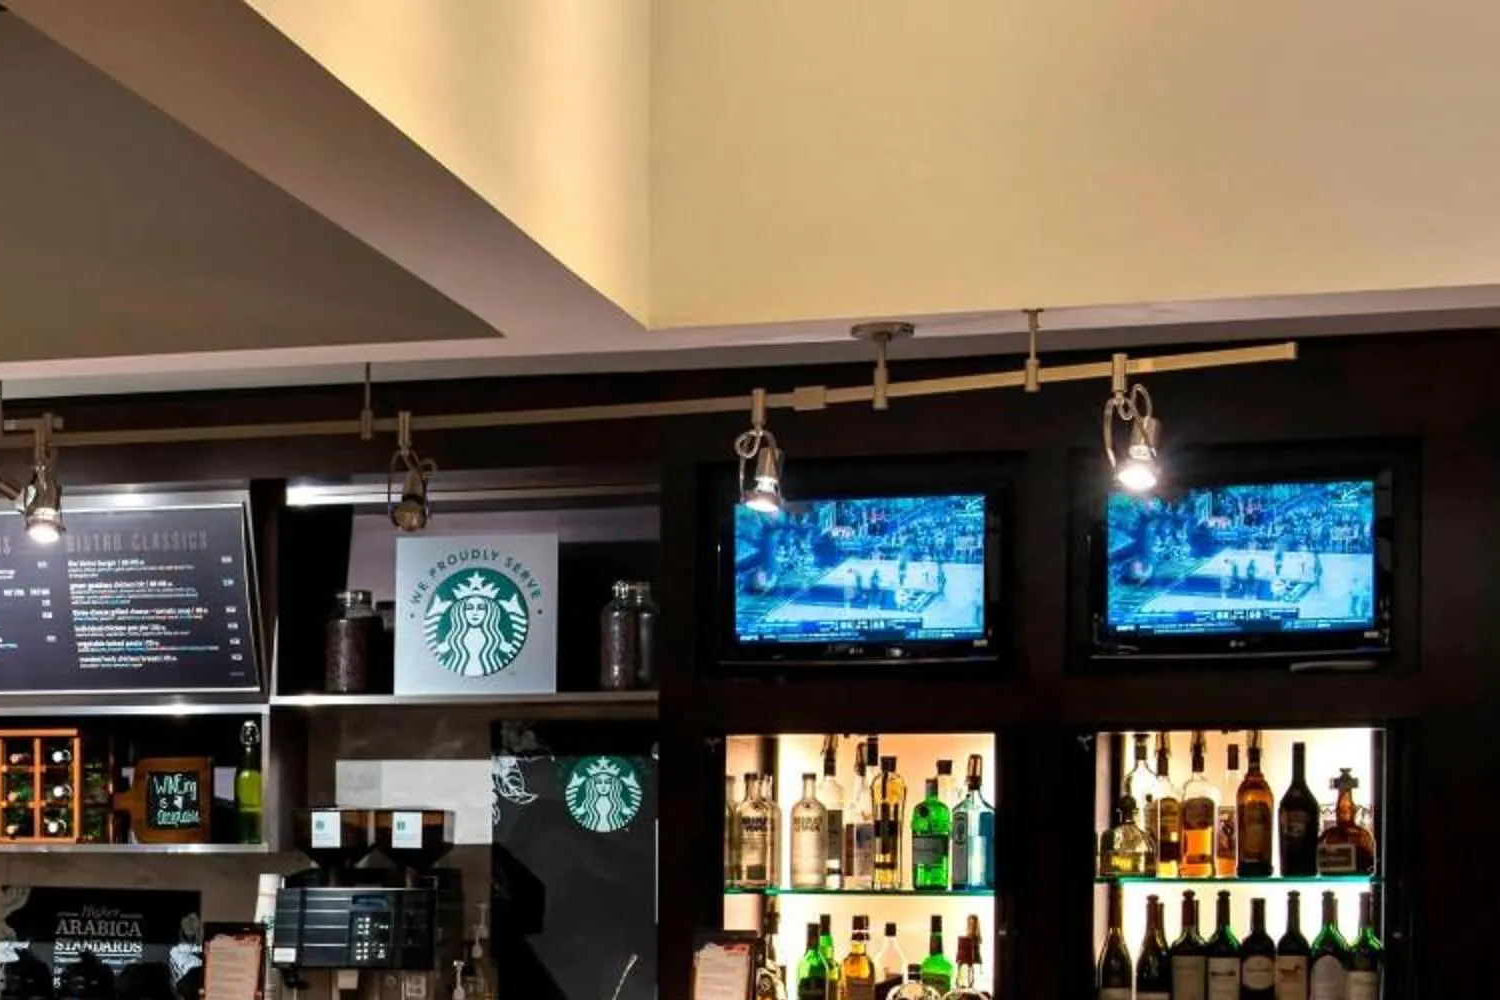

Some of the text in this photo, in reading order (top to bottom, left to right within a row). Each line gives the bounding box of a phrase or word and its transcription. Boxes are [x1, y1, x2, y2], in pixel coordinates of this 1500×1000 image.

[132, 530, 208, 550] CLASSICS
[408, 548, 543, 606] WE PROUDLY SERVE
[55, 918, 143, 937] ARABICA
[53, 937, 143, 953] STANDARDS
